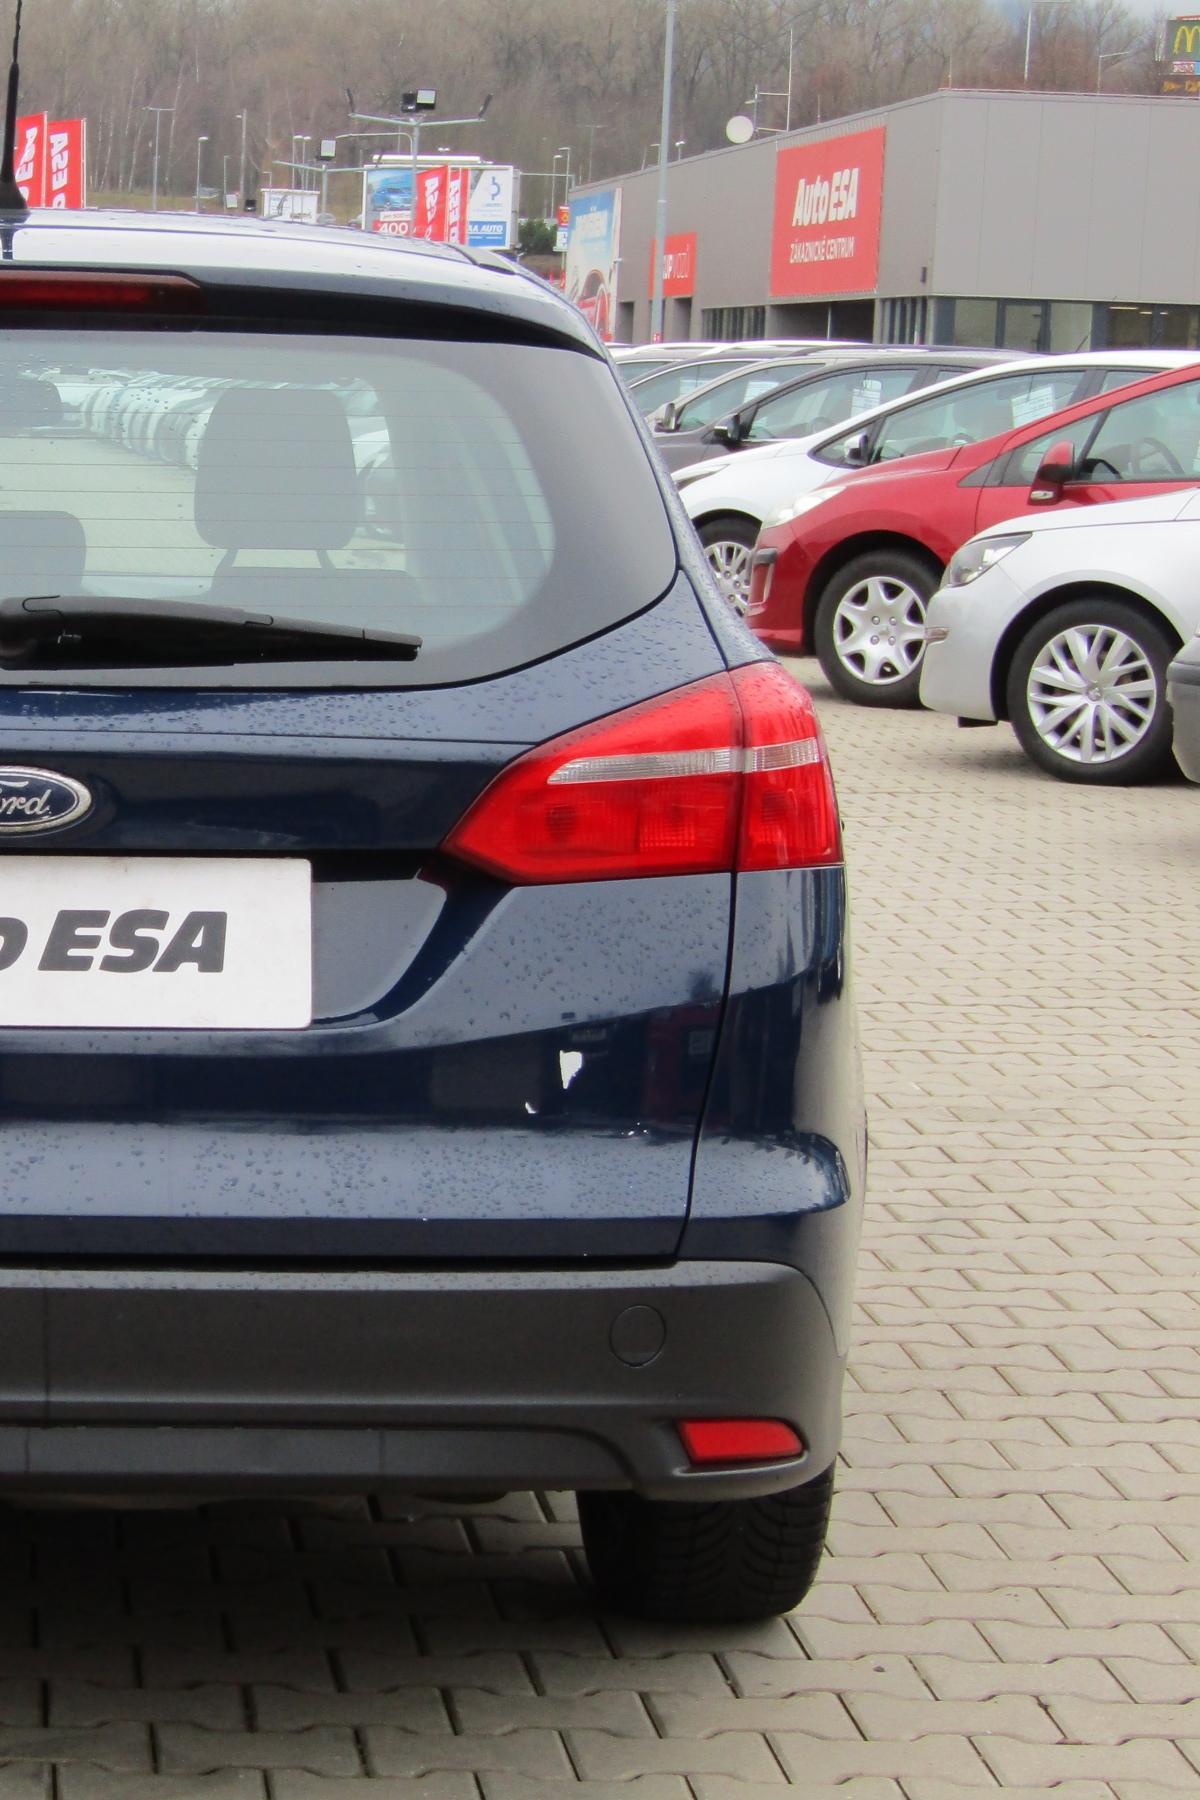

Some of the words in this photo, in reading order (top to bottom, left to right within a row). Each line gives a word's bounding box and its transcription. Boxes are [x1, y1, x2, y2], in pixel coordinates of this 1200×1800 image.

[791, 174, 830, 226] Auto
[828, 167, 859, 222] ESA
[480, 224, 504, 233] AUTO
[790, 236, 826, 263] ZÁKAZNICKÉ
[826, 236, 855, 260] CENTRUM
[37, 909, 229, 974] ESA
